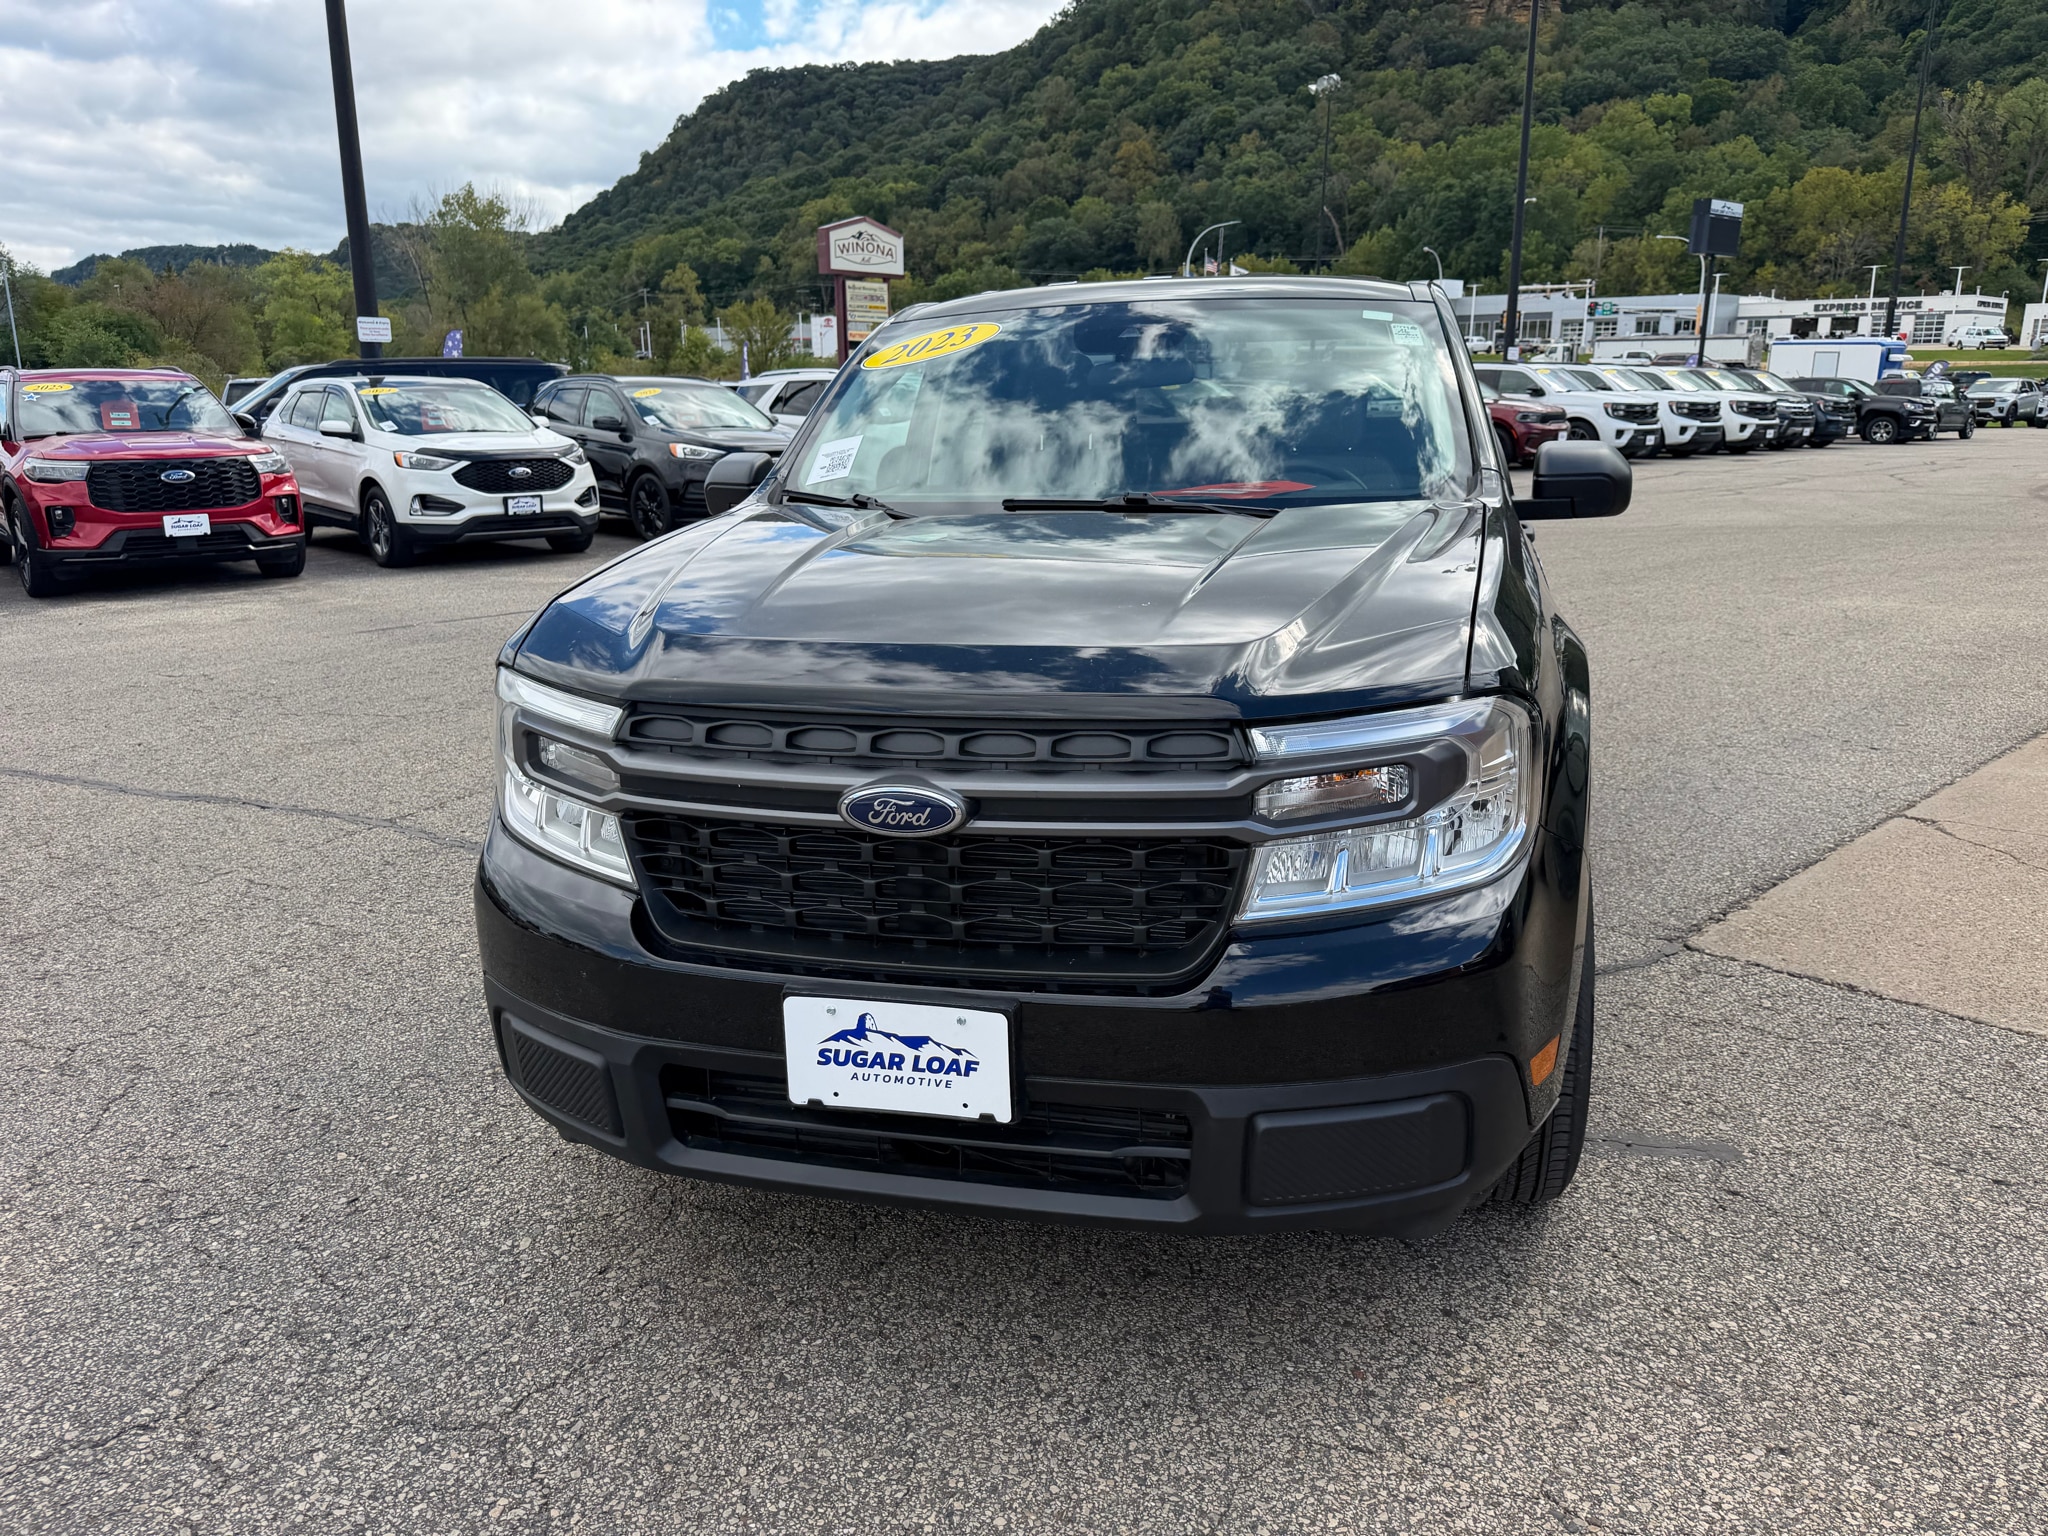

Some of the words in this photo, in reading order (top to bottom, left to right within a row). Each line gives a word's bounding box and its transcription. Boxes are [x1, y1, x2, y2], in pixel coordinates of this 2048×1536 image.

[837, 241, 894, 260] WINONA
[1813, 302, 1867, 312] EXPRESS
[879, 325, 979, 366] 2023
[169, 472, 188, 480] Ford
[868, 797, 932, 827] Ford
[816, 1047, 906, 1072] SUGAR
[911, 1054, 980, 1078] LOAF
[850, 1072, 953, 1089] AUTOMOTIVE
